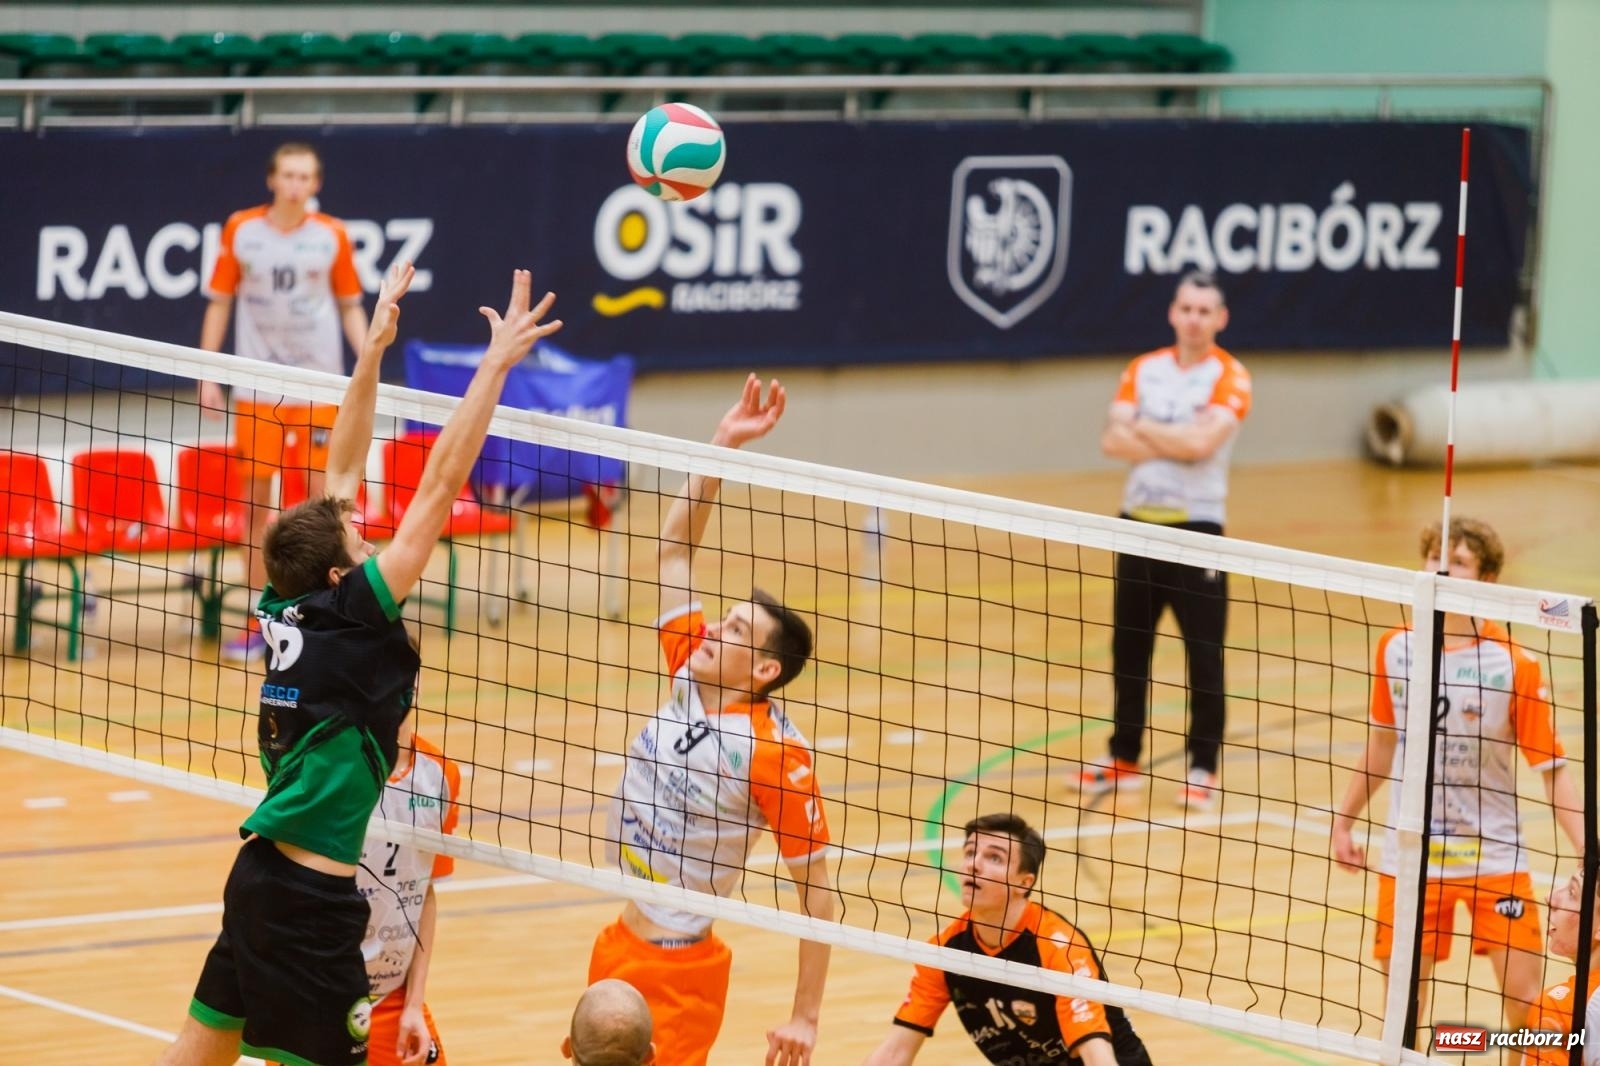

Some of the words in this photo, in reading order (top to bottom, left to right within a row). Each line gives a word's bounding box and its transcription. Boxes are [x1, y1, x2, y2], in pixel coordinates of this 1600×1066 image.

[37, 197, 434, 301] RACIRZ
[1124, 180, 1442, 275] RACIBÓRZ
[272, 266, 296, 293] 10
[408, 794, 436, 811] plus
